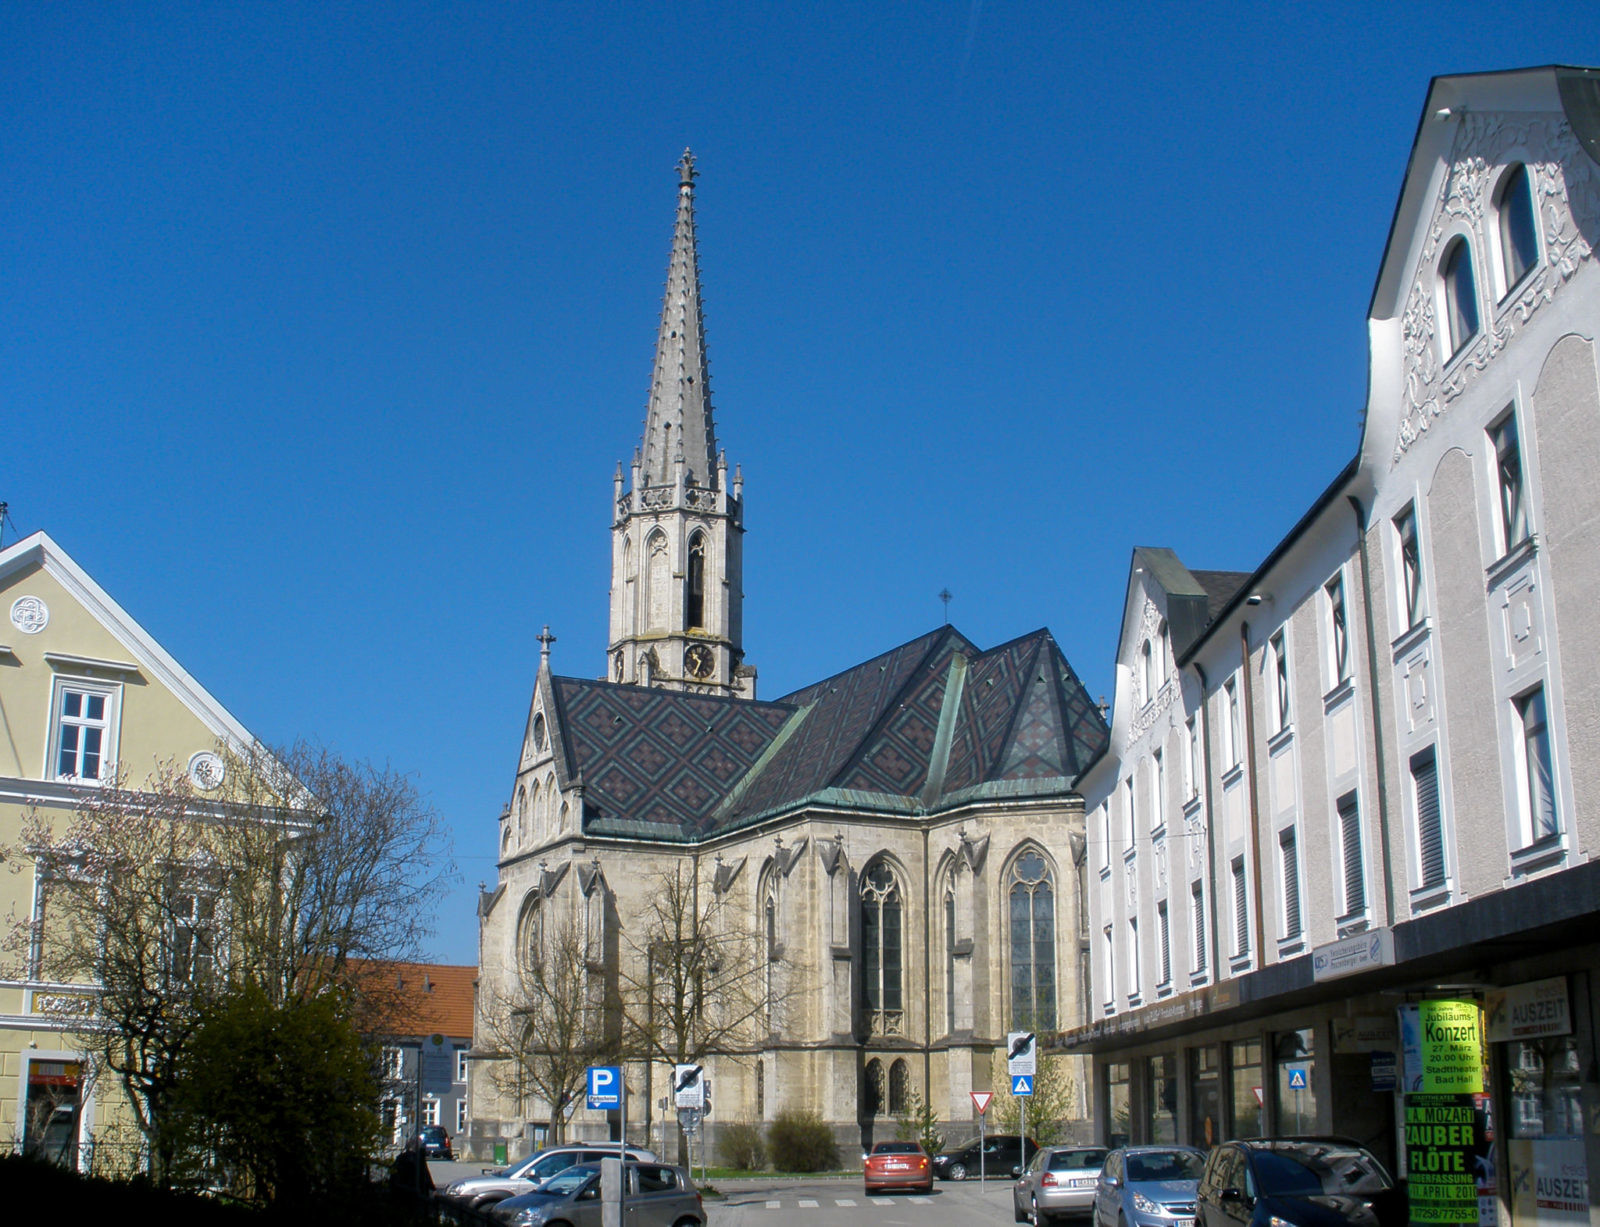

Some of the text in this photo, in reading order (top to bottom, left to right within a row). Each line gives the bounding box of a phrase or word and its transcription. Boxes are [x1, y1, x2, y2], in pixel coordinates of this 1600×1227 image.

[1426, 1012, 1475, 1022] Jubiläums-
[1512, 999, 1566, 1024] AUSZEIT
[1426, 1023, 1476, 1042] Konzert
[1430, 1053, 1475, 1062] 20.00 Uhr
[1426, 1065, 1479, 1074] Stadttheater
[592, 1069, 613, 1095] P
[1435, 1075, 1474, 1084] Bad Hall
[1425, 1107, 1475, 1123] MOZART
[1405, 1124, 1475, 1146] ZAUBER
[1410, 1146, 1465, 1172] FLÖTE
[1424, 1186, 1453, 1198] APRIL
